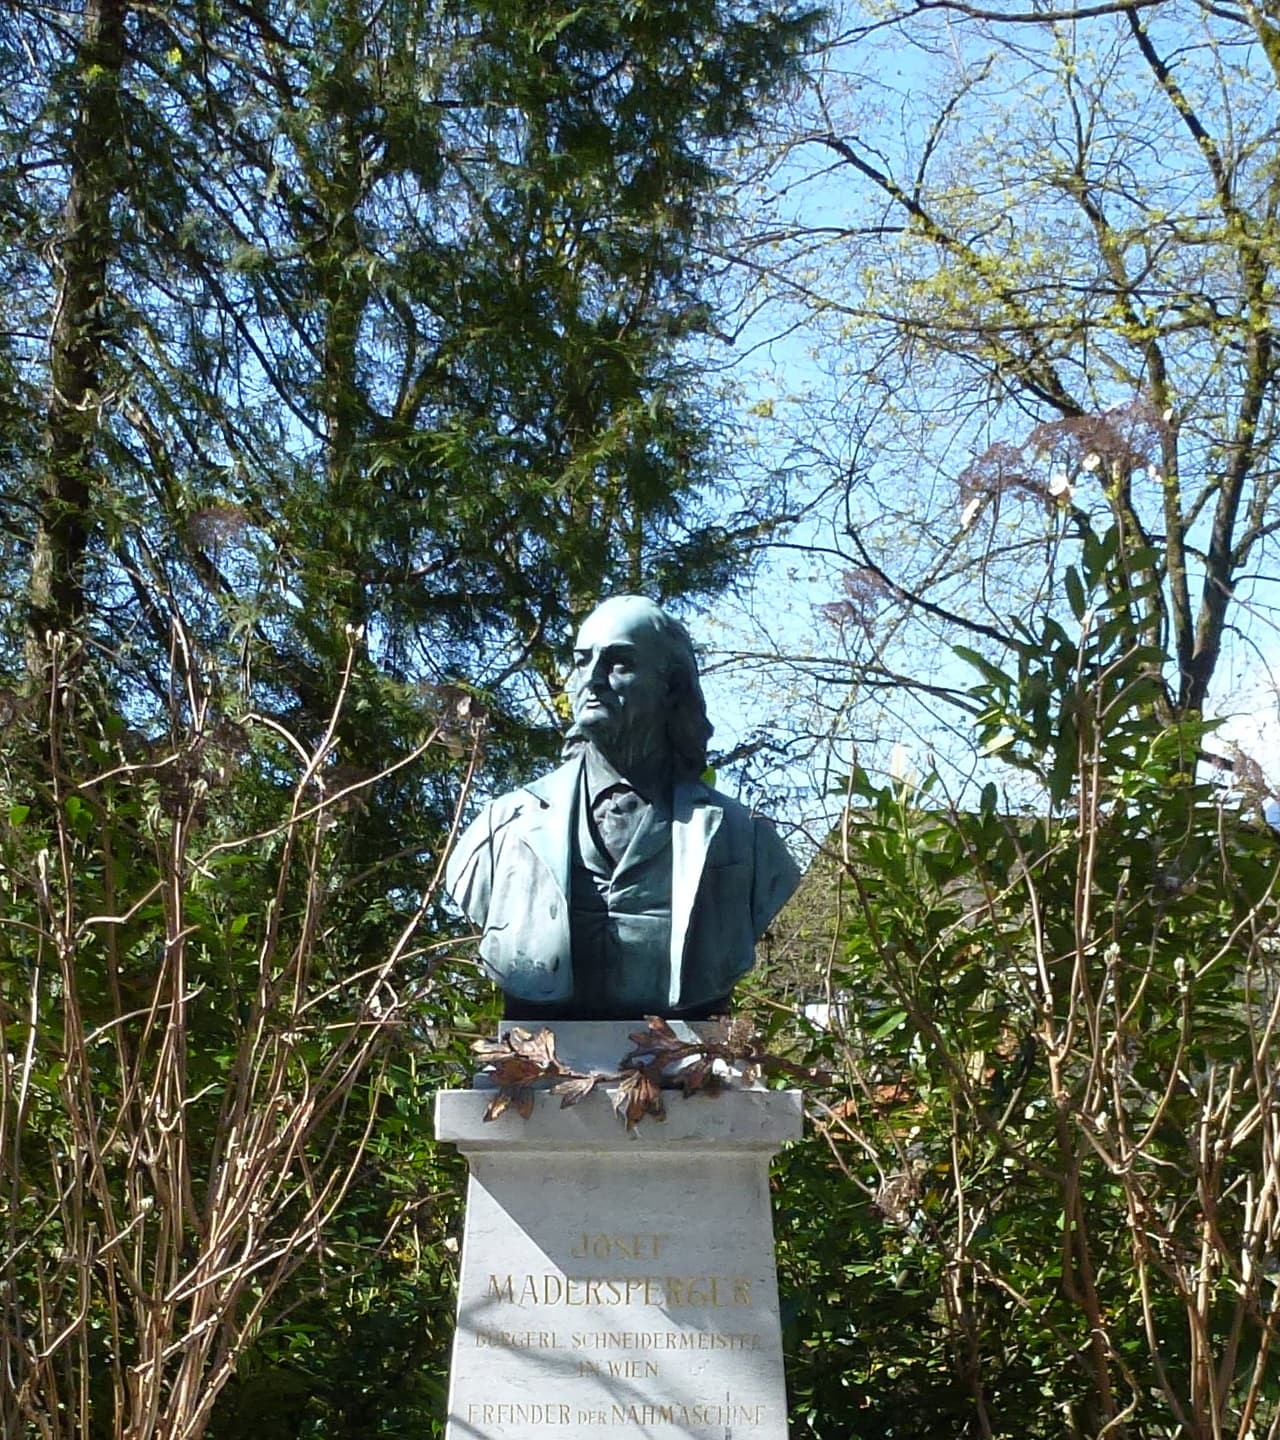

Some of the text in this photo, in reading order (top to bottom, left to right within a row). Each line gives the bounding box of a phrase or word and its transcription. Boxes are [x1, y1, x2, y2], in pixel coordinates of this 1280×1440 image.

[570, 1231, 670, 1260] JOSEF
[488, 1273, 753, 1309] MADERSPERGER
[572, 1331, 761, 1350] SCHNEIDERMEISTER
[577, 1360, 658, 1378] IN WIEN
[468, 1403, 571, 1426] ERFINDER
[578, 1411, 607, 1425] DER
